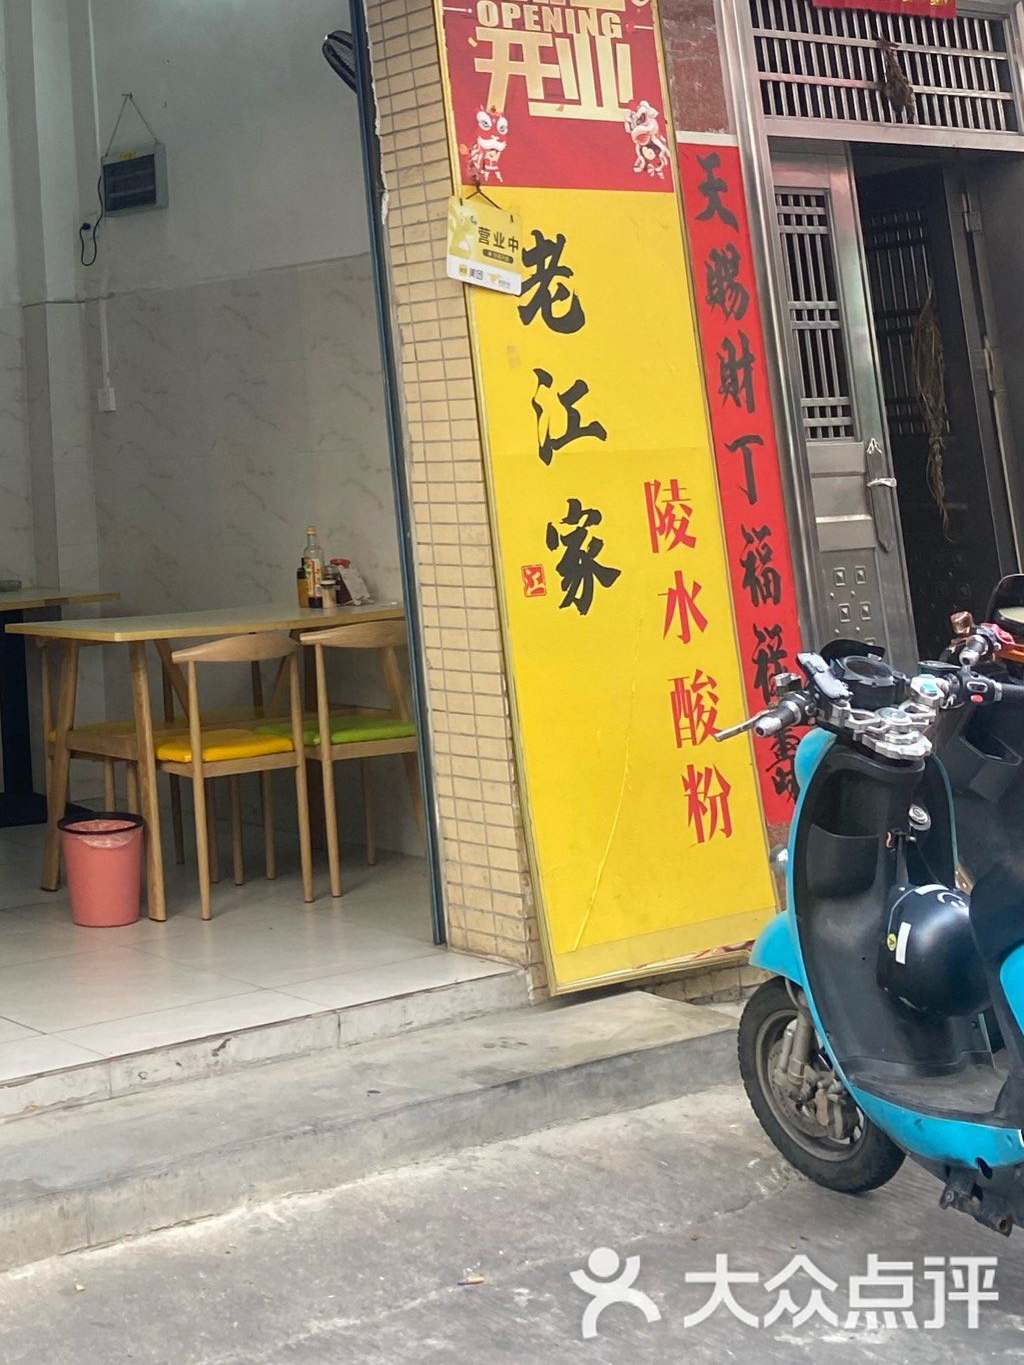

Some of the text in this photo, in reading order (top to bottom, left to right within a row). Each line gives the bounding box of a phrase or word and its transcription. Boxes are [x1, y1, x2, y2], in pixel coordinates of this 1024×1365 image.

[476, 0, 623, 39] OPENING
[474, 26, 633, 122] 开业
[478, 226, 519, 253] 营业中
[517, 230, 622, 615] 老江家
[644, 479, 732, 845] 陵水酸粉
